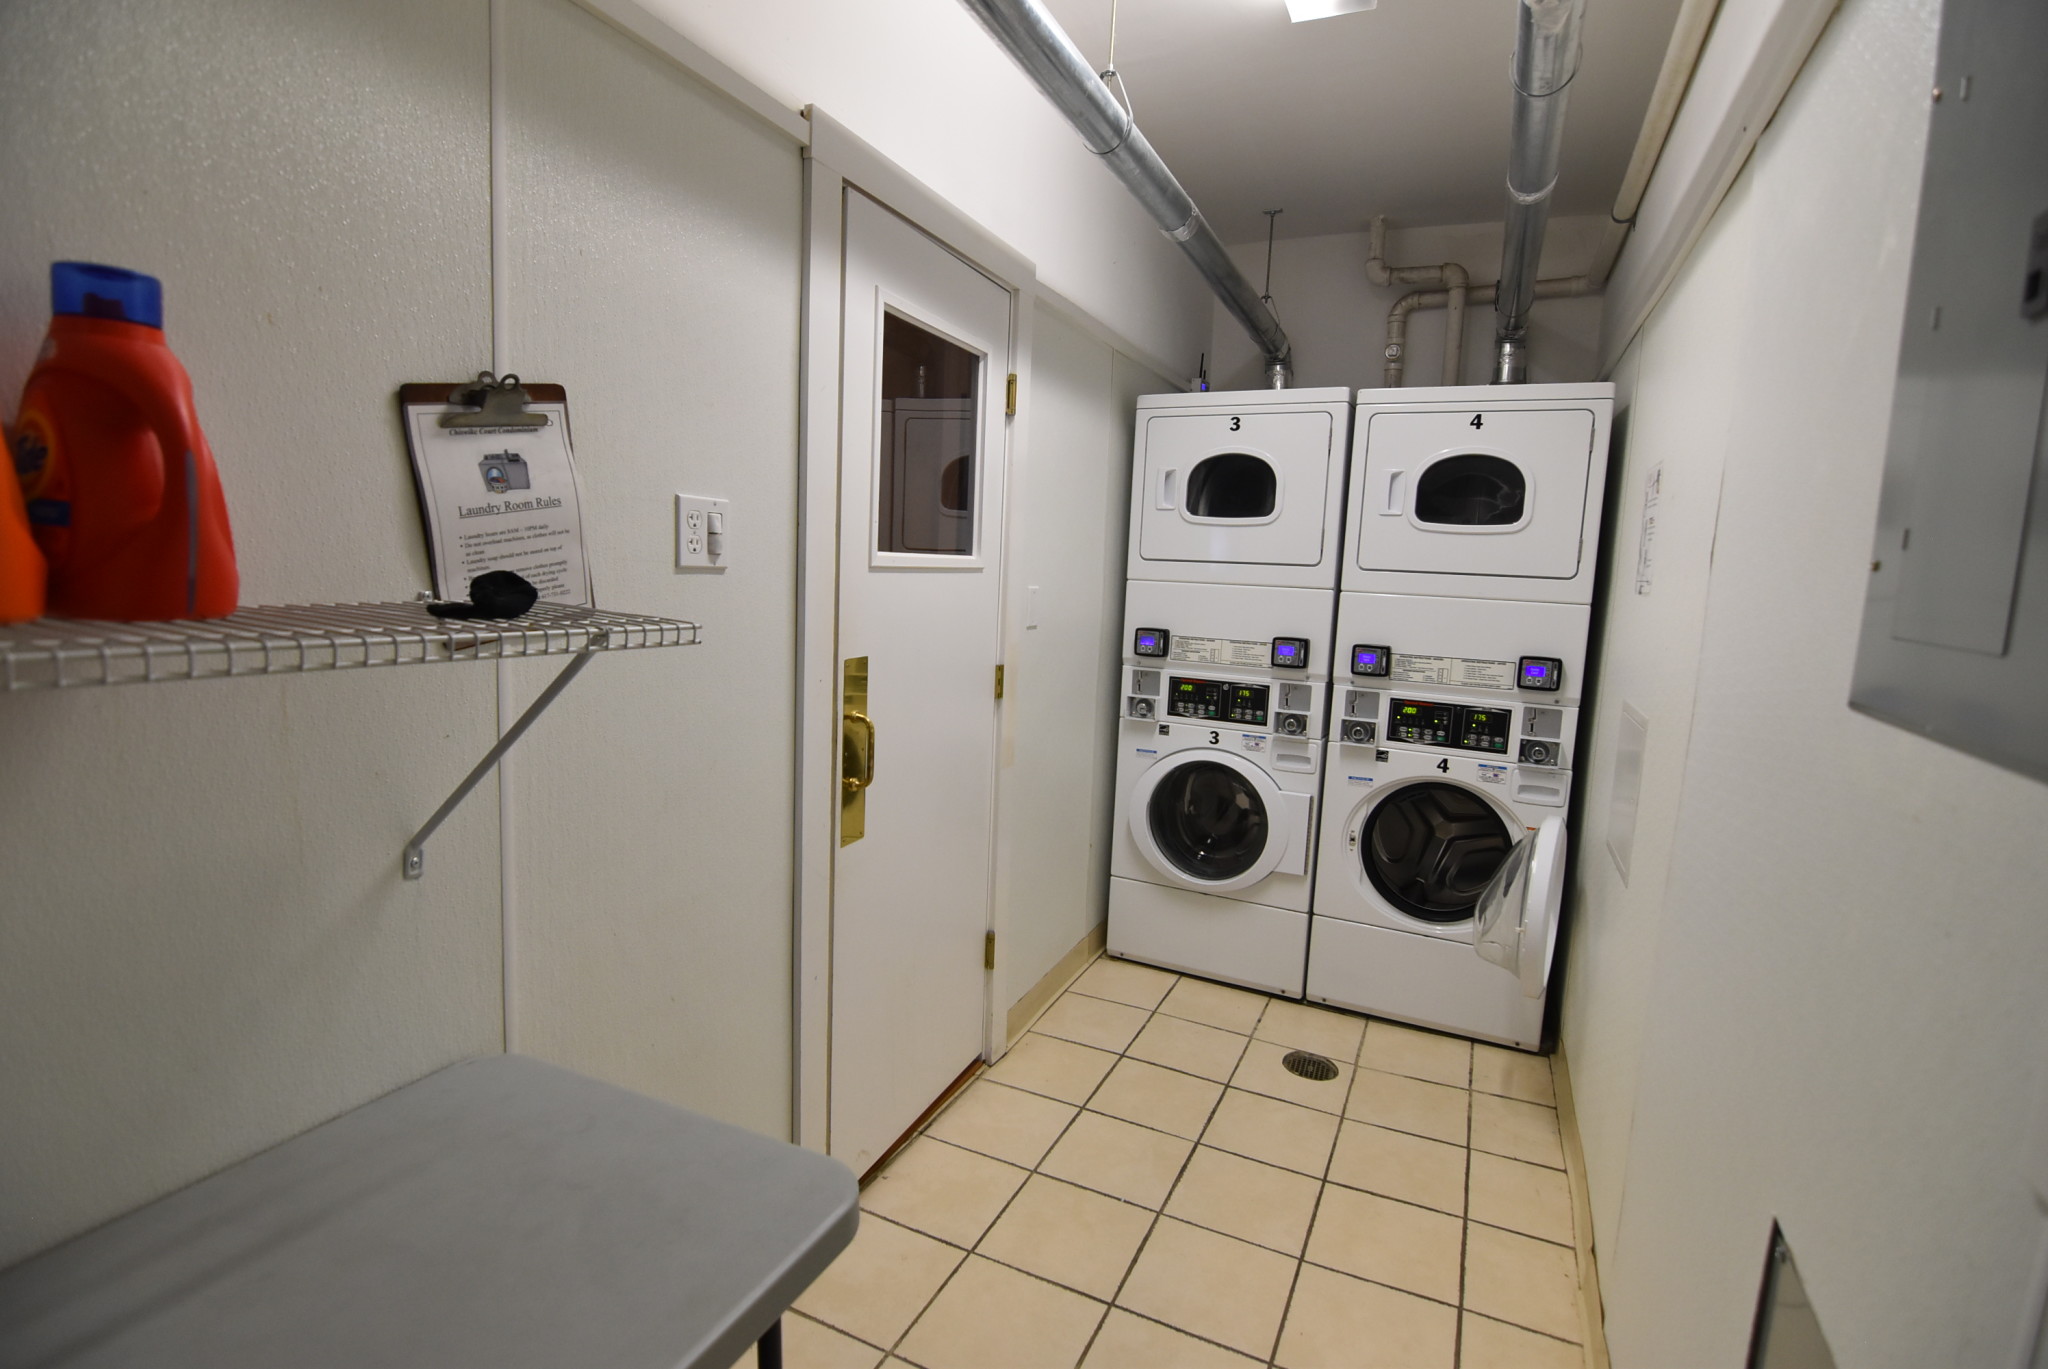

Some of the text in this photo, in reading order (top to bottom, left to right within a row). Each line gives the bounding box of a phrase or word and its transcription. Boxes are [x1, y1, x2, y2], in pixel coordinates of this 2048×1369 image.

[1229, 416, 1241, 431] 3
[1470, 413, 1483, 430] 4
[458, 496, 562, 517] Laundry Room Rules
[1402, 706, 1417, 714] 200
[1209, 731, 1220, 745] 3
[1436, 758, 1450, 774] 4
